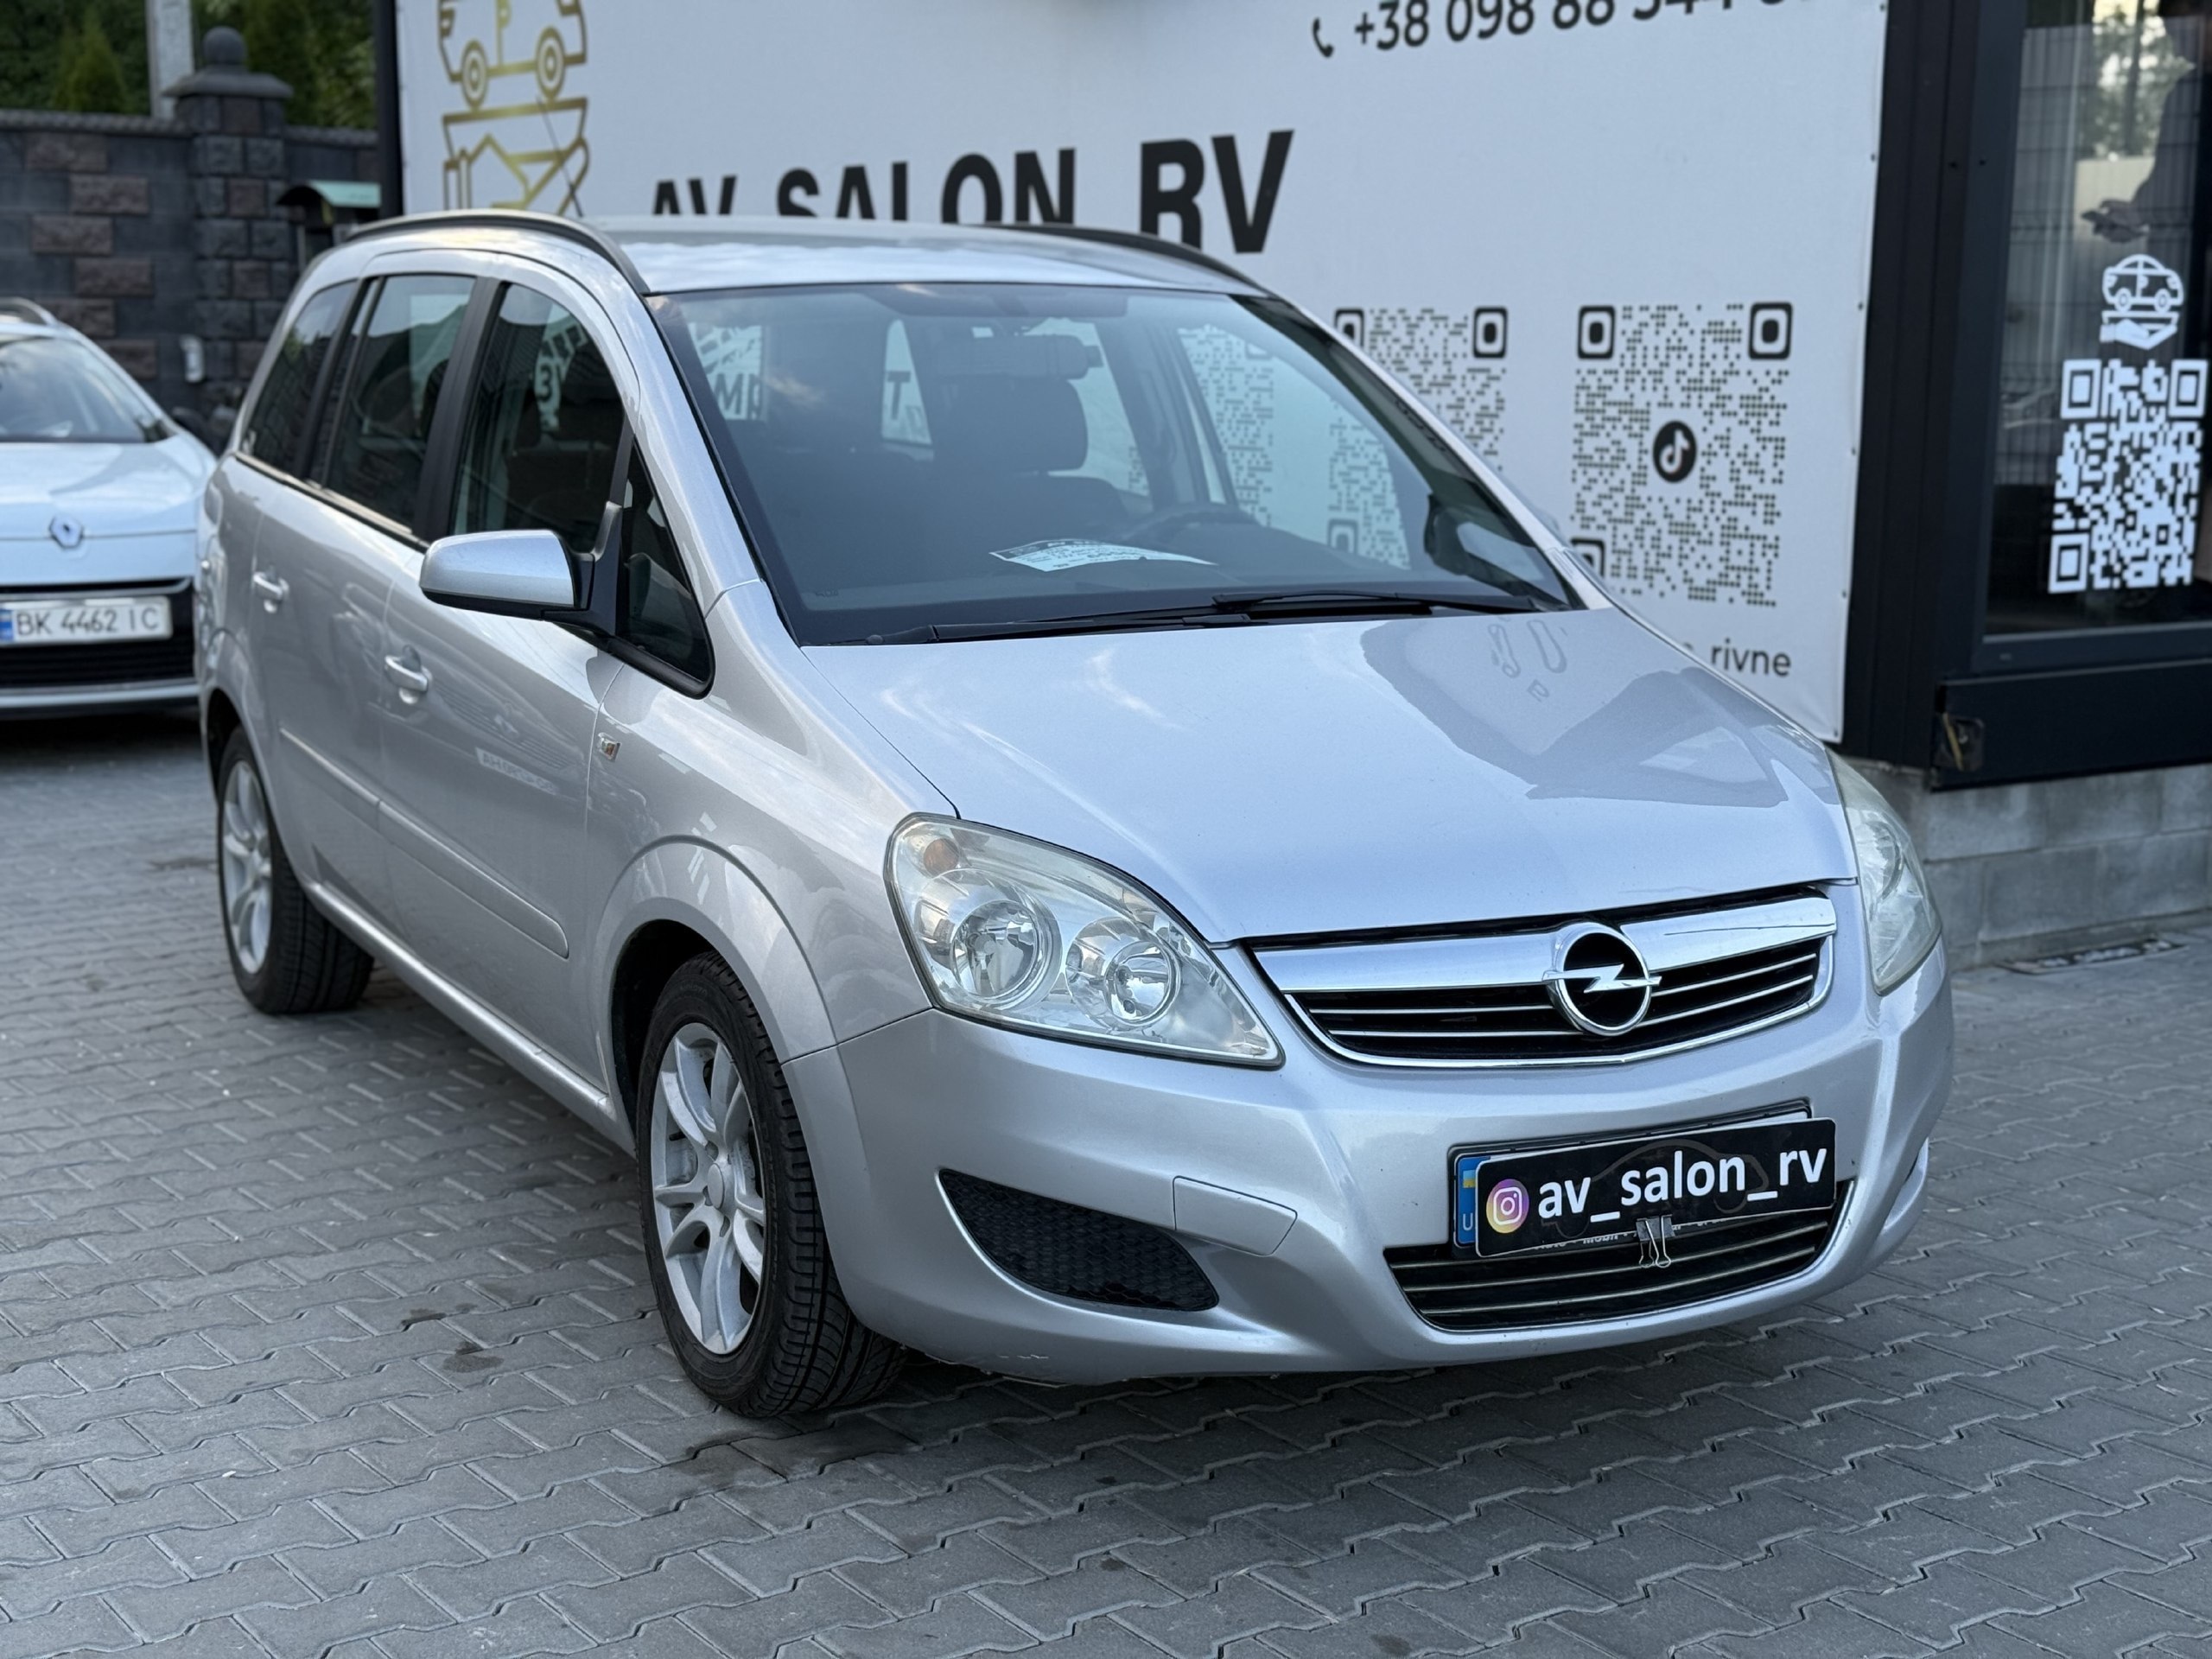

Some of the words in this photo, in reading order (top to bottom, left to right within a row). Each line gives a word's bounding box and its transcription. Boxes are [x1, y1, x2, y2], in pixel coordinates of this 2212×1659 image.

[1354, 0, 1430, 50] +38
[1446, 0, 1535, 42] 098
[1140, 130, 1294, 253] RV
[16, 611, 52, 636] BK
[60, 609, 118, 633] 4462
[130, 607, 158, 631] IC
[1711, 638, 1791, 677] rivne
[1538, 1149, 1827, 1223] av_salon_rv
